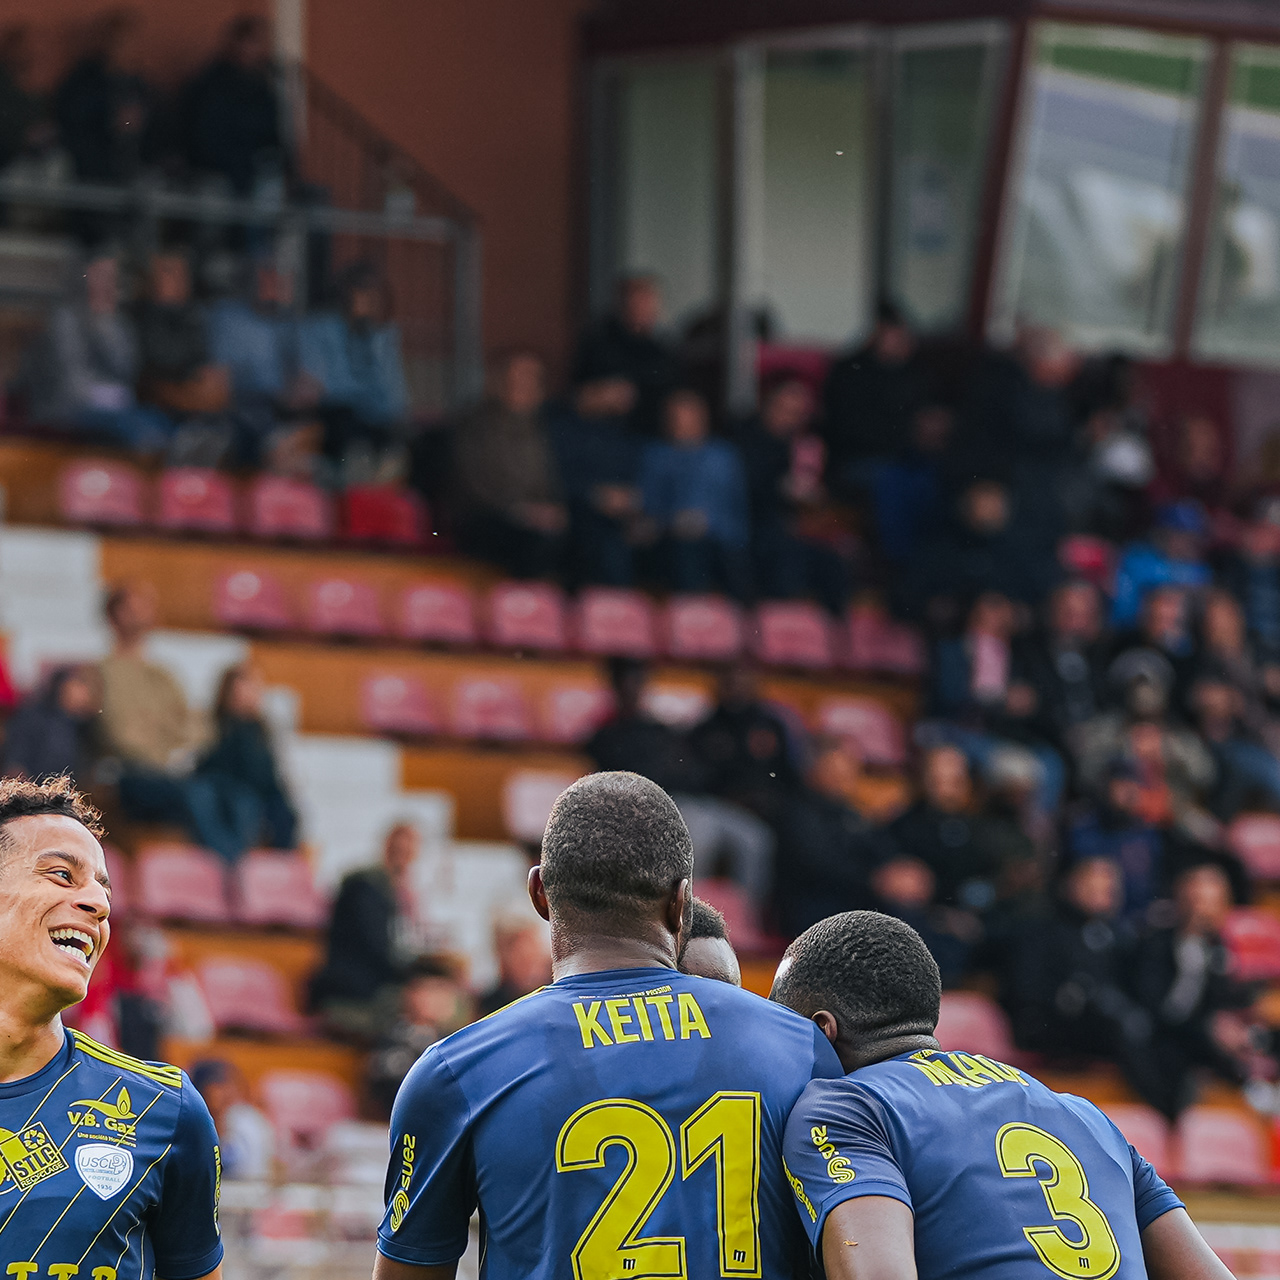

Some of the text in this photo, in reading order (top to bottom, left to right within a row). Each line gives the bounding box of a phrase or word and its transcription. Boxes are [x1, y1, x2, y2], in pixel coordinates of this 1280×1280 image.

[572, 993, 712, 1048] KEITA
[67, 1110, 136, 1136] V.B. Gaz
[12, 1146, 58, 1178] STLC
[20, 1161, 65, 1188] RECYCLAGE
[401, 1133, 416, 1191] suez
